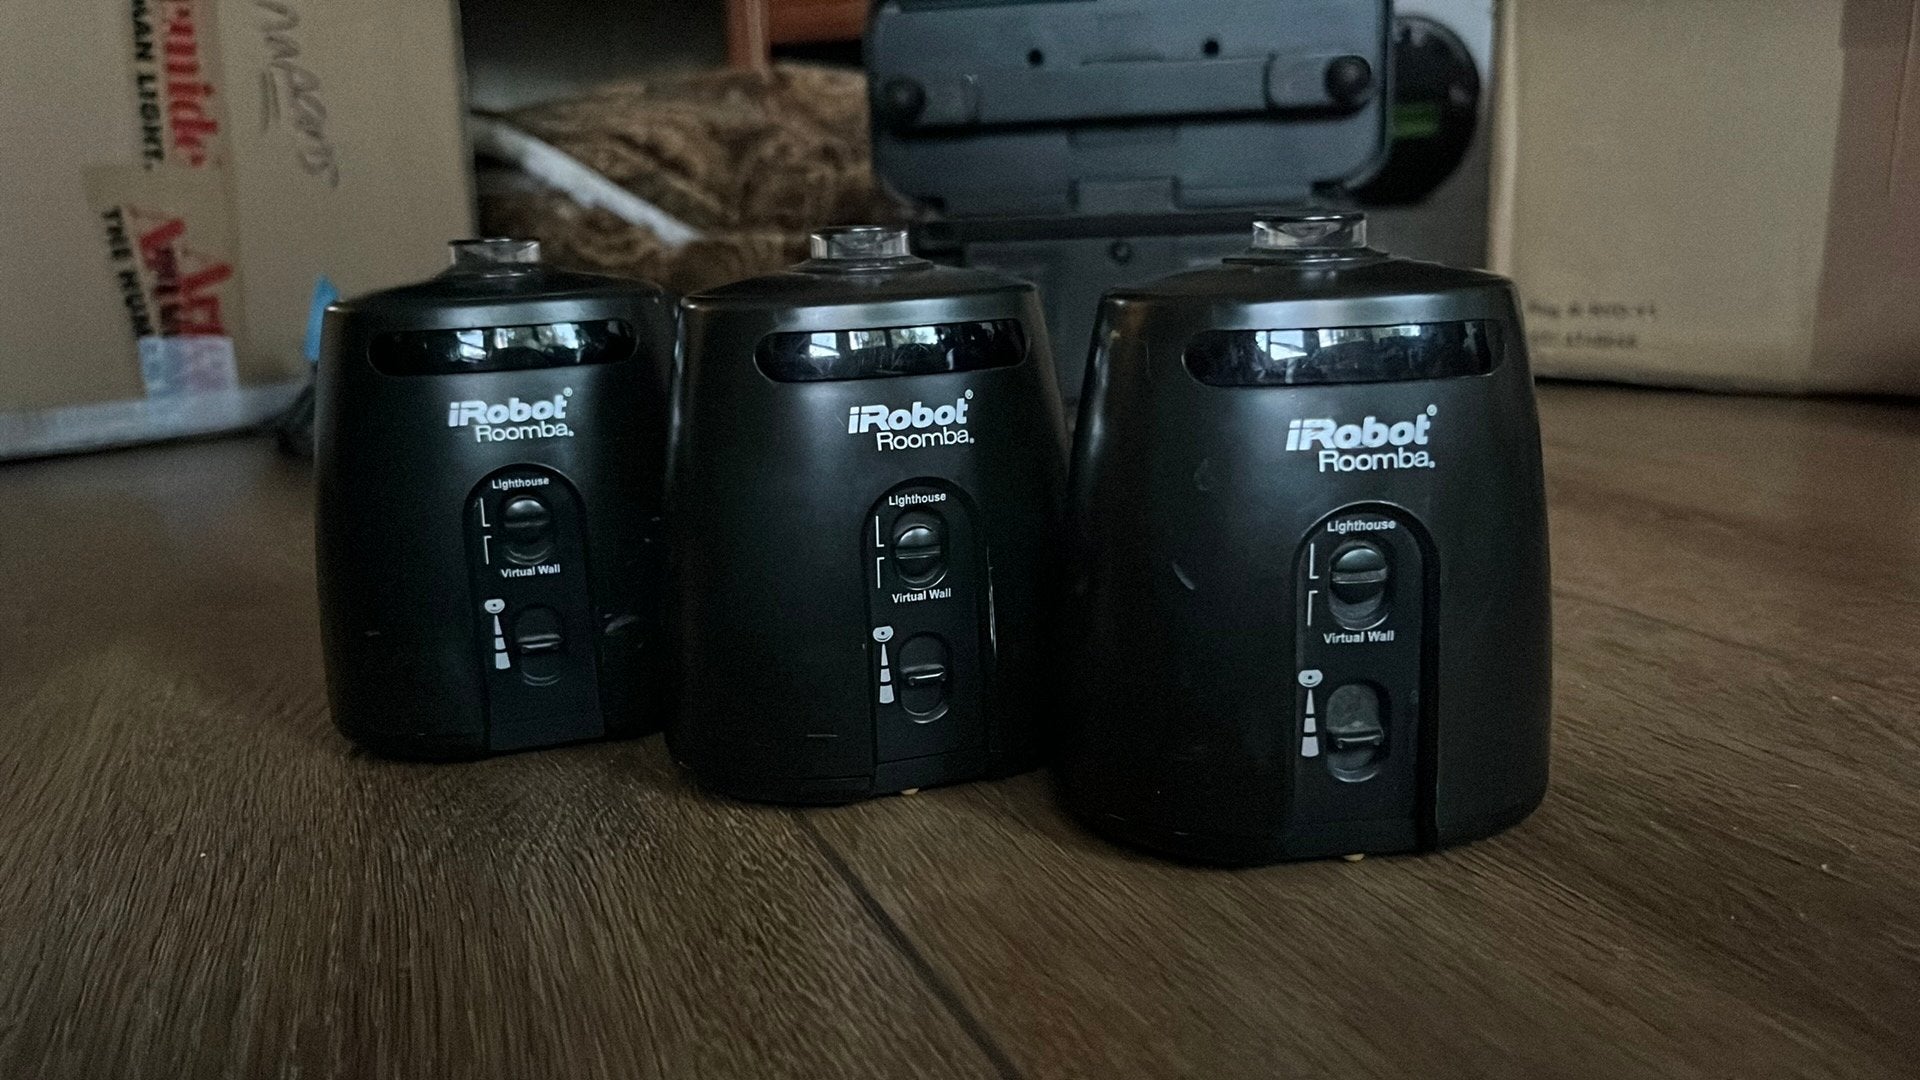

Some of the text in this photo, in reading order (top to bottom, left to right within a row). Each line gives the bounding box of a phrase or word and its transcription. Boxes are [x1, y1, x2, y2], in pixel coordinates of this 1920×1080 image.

[491, 477, 550, 491] Lighthouse
[888, 493, 947, 507] Lighthouse
[1326, 519, 1397, 535] Lighthouse
[500, 563, 561, 578] Virtual Wall
[891, 587, 952, 603] Virtual Wall
[1323, 630, 1395, 644] Virtual Wall
